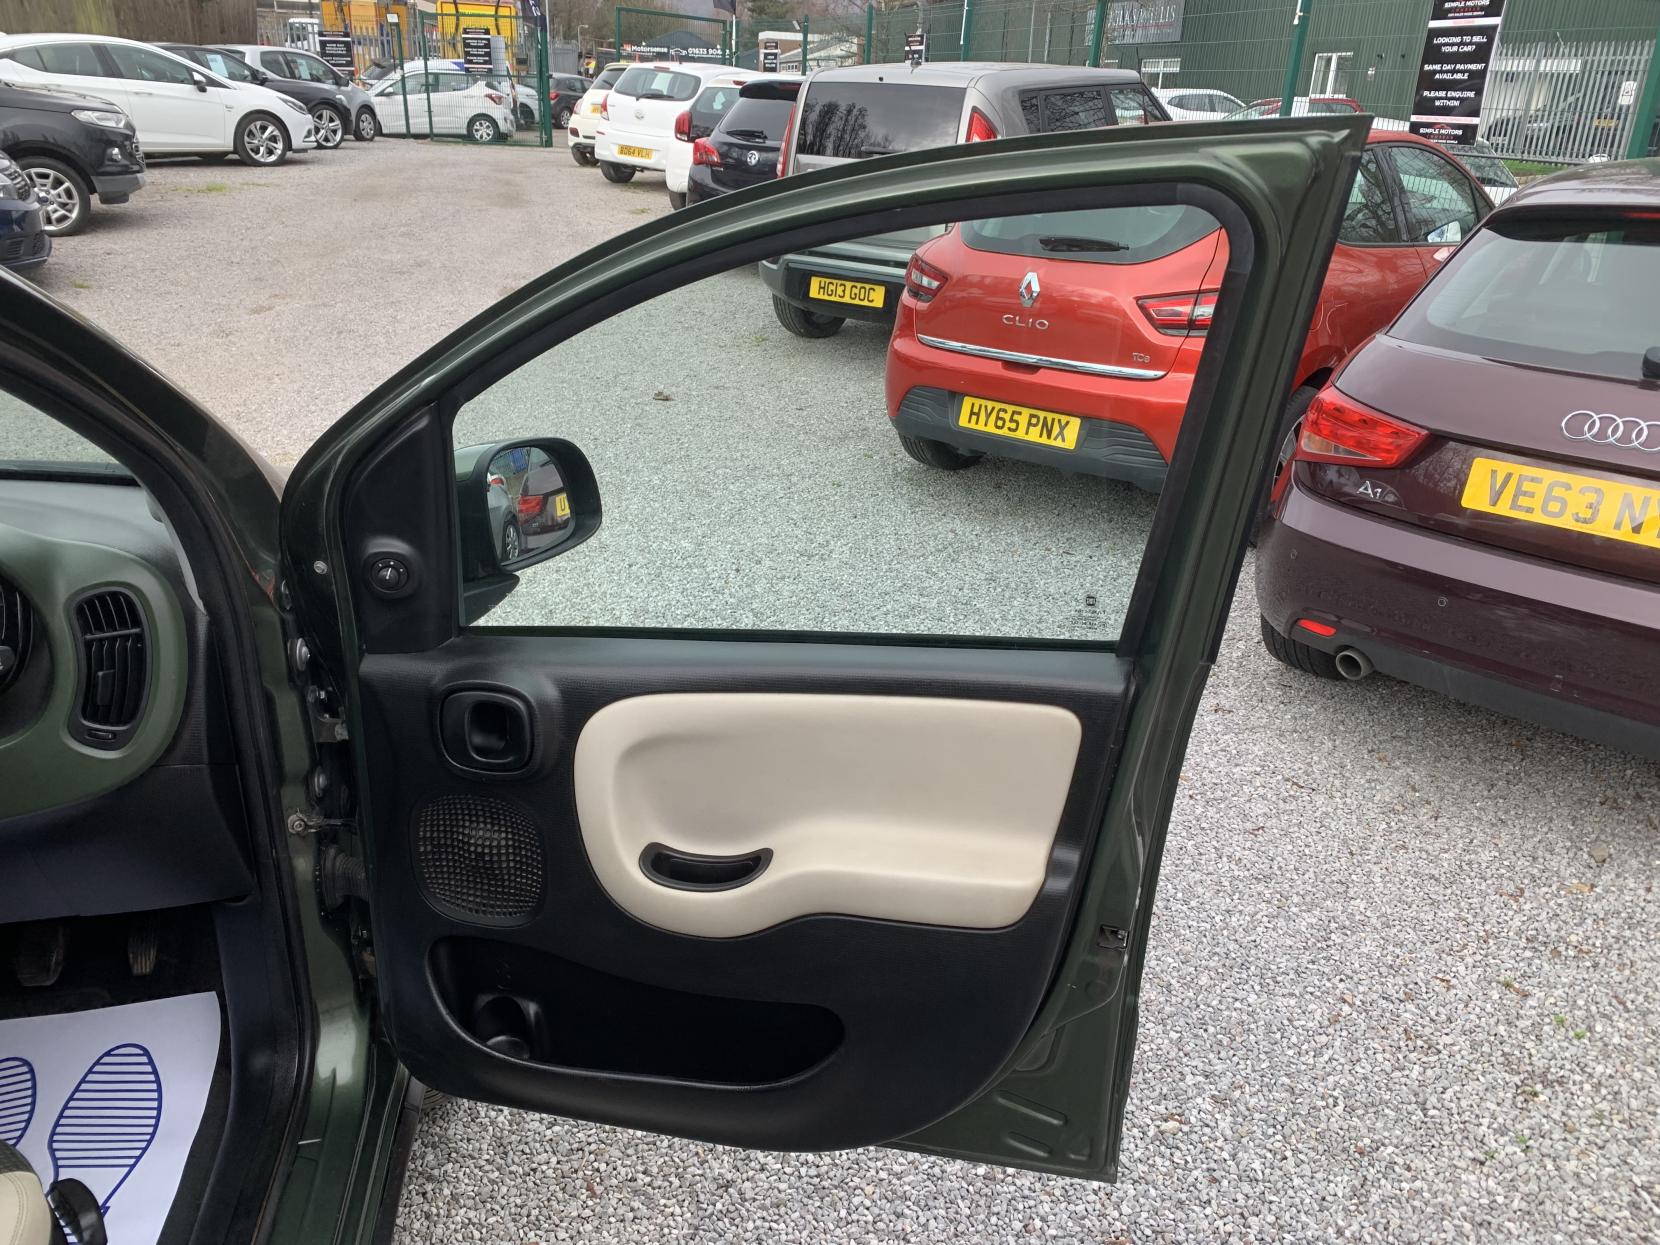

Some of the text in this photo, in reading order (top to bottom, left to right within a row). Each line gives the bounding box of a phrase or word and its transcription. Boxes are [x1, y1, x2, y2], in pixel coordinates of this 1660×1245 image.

[818, 280, 876, 303] HG13 GOC
[1002, 314, 1049, 330] CLIO
[967, 402, 1070, 443] HY65 PNX
[1356, 480, 1383, 501] A1
[1489, 468, 1606, 526] VE63
